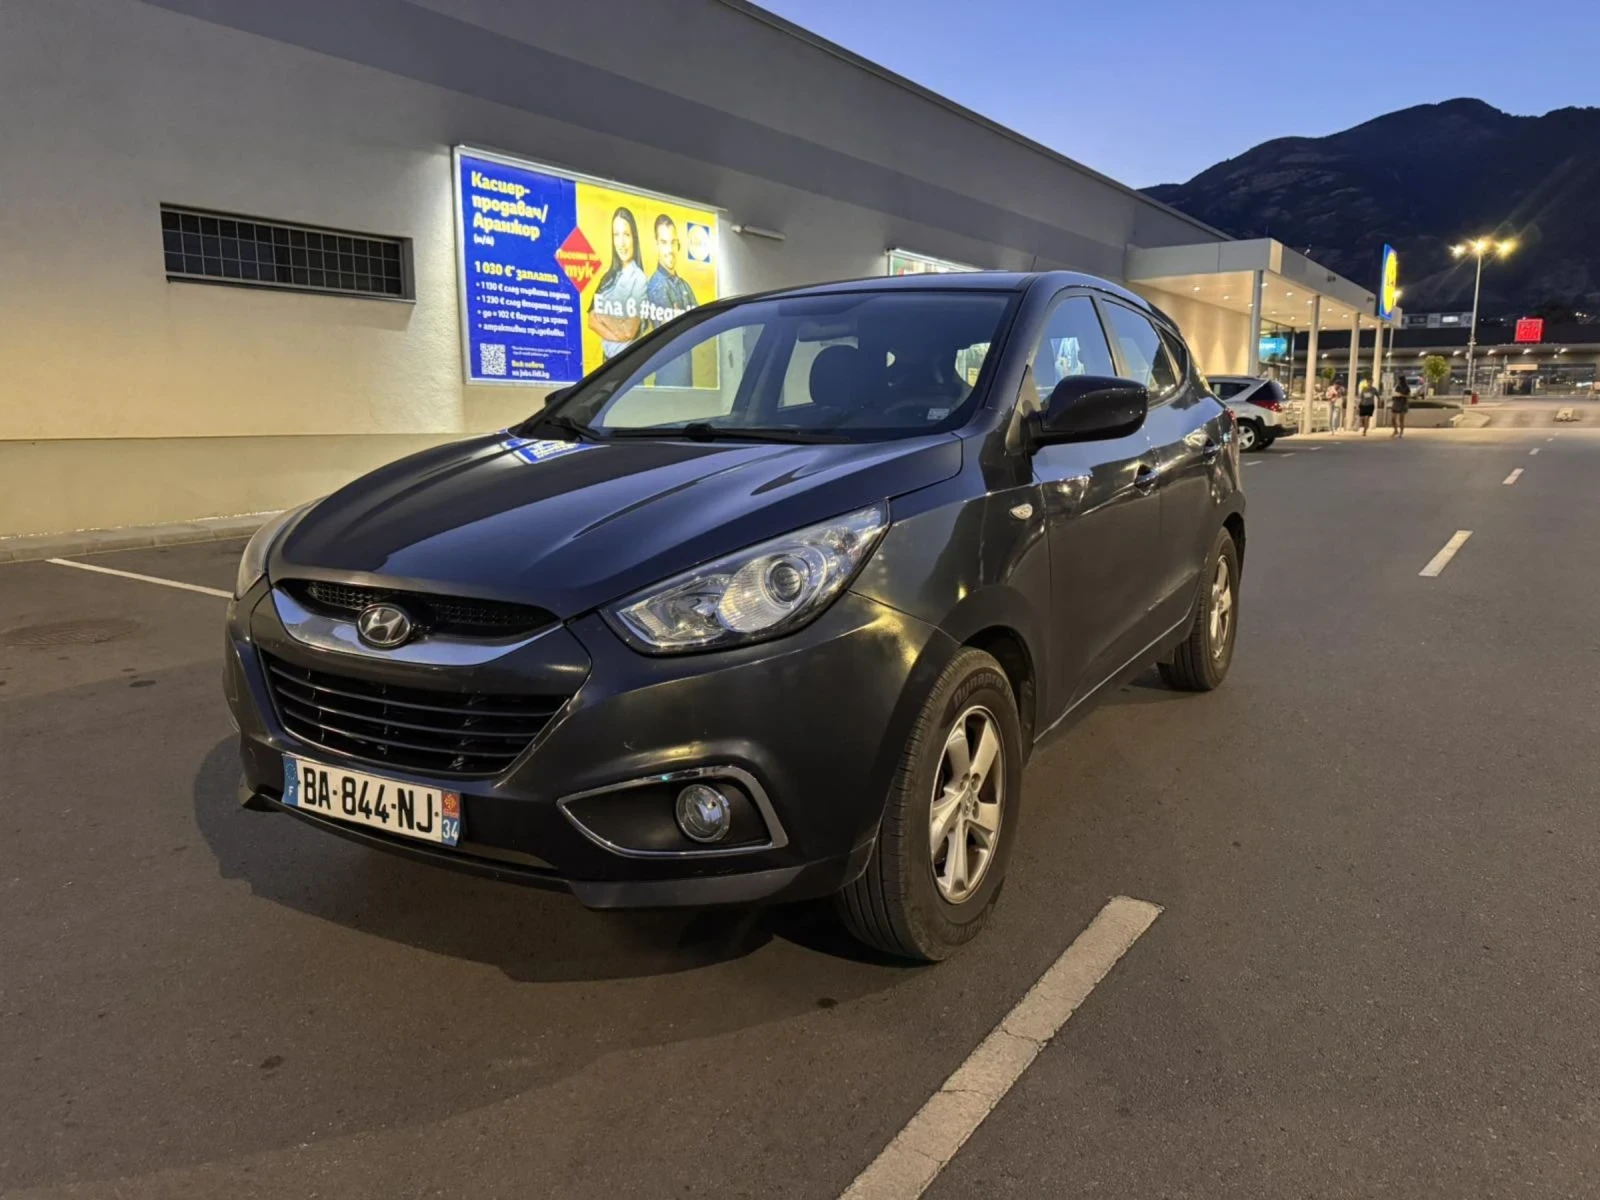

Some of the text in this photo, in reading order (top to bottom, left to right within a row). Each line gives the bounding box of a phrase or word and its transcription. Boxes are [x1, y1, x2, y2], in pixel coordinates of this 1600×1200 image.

[471, 170, 531, 200] Касиер-
[471, 194, 549, 223] продавач/
[472, 211, 541, 242] Аранжор
[474, 260, 481, 273] 1
[482, 261, 503, 276] 030
[515, 269, 559, 284] заплата
[564, 261, 596, 282] тук
[503, 285, 520, 295] след
[548, 291, 571, 300] година
[482, 310, 492, 318] до
[515, 311, 542, 323] ваучери
[542, 316, 550, 324] за
[505, 299, 521, 308] след
[521, 299, 551, 310] втората
[551, 304, 573, 313] година
[593, 293, 624, 317] Ела
[626, 297, 637, 318] в
[287, 786, 294, 796] F
[302, 766, 433, 834] BA-844-NJ
[442, 819, 459, 841] 34
